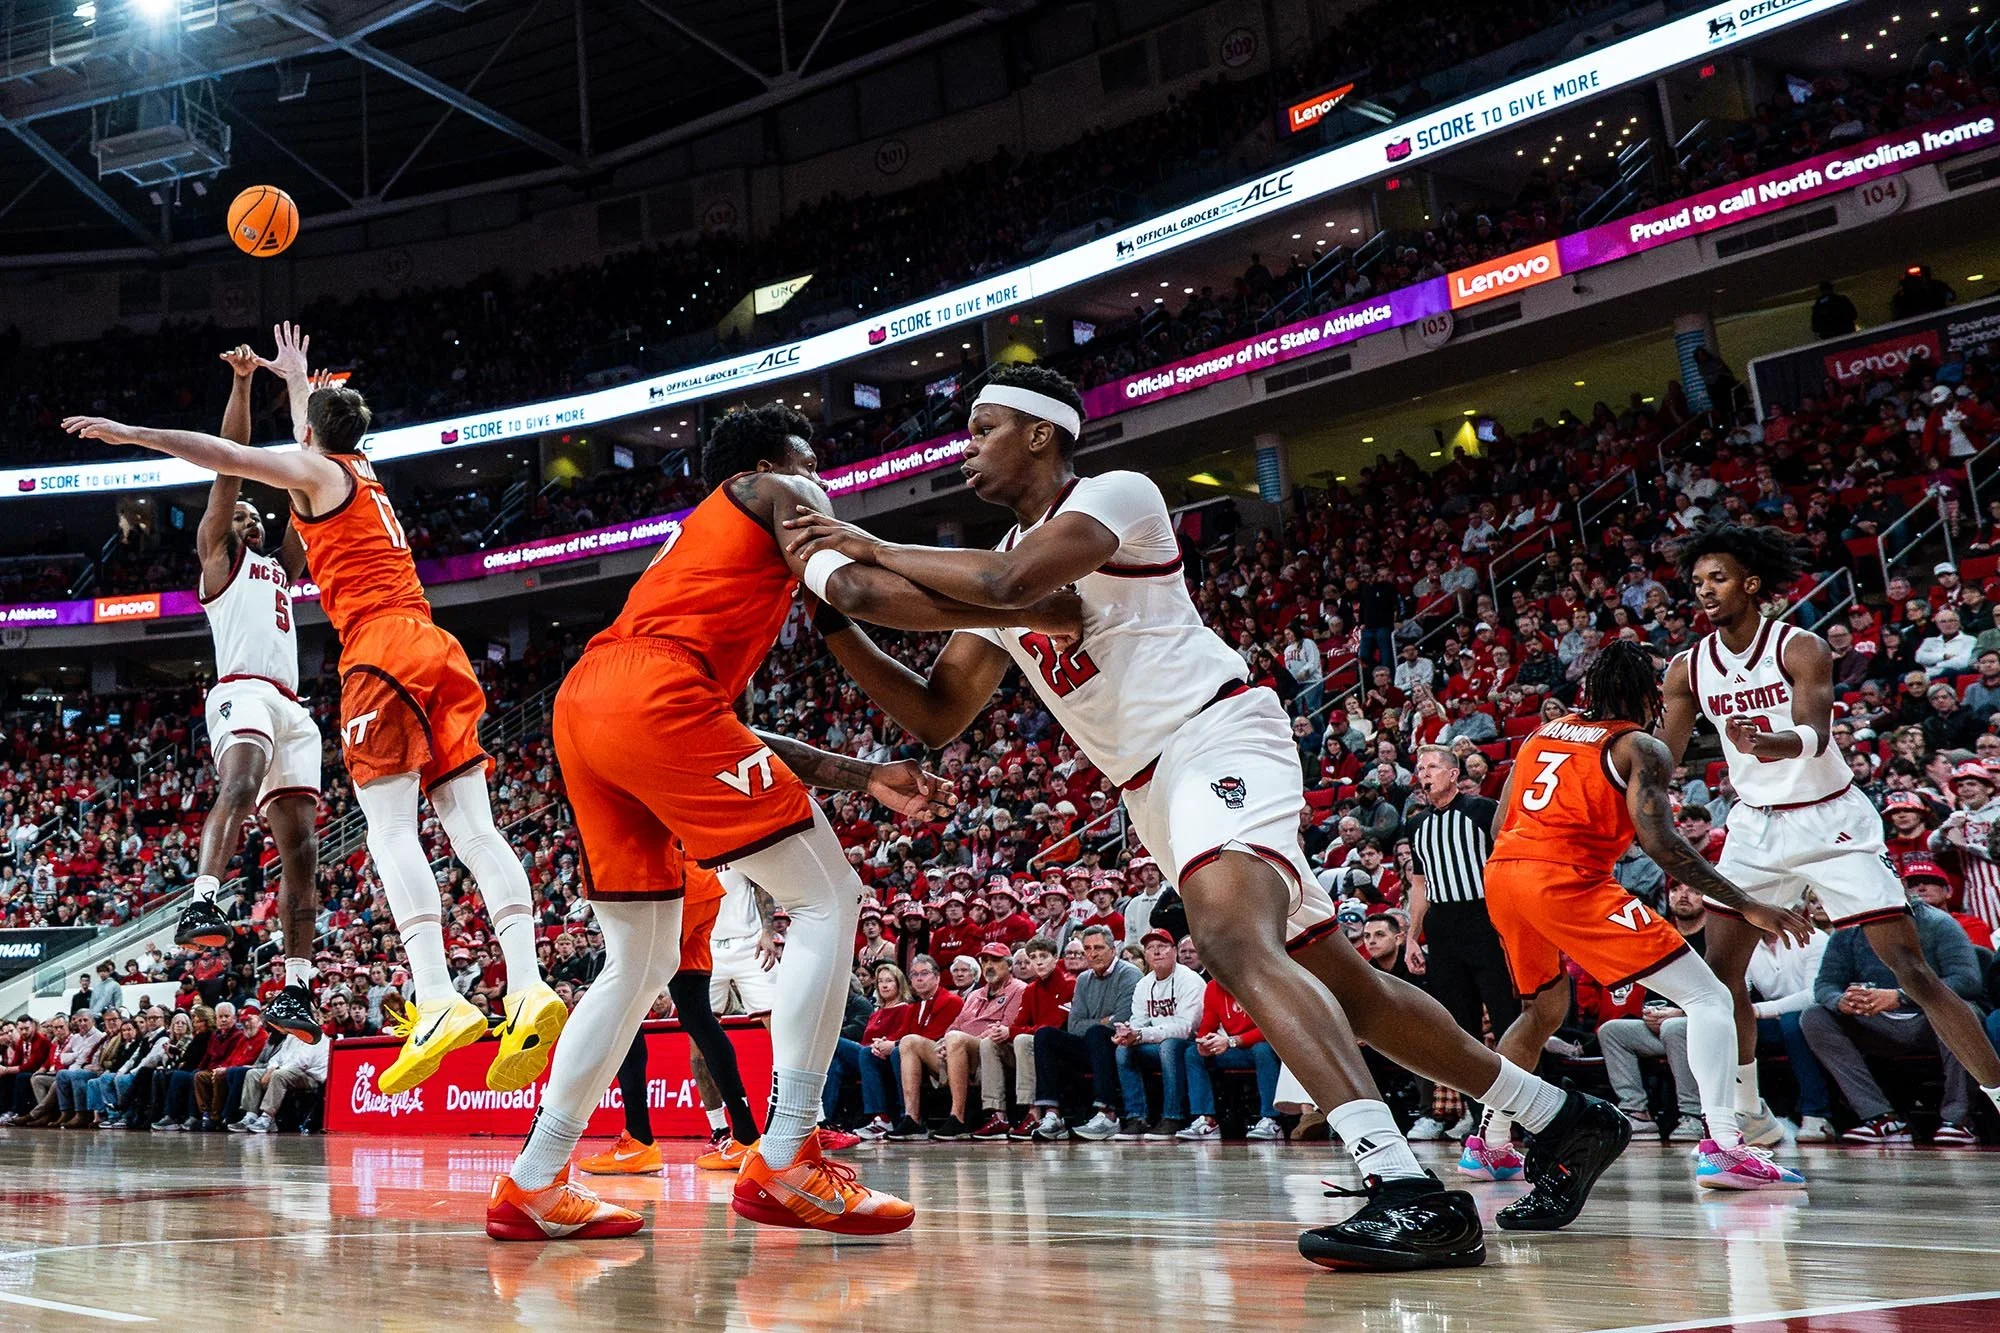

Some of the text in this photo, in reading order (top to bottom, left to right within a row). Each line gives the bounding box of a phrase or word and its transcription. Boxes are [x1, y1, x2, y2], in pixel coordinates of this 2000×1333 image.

[1740, 0, 1797, 20] OFFICI
[1294, 93, 1344, 125] Lenov
[1417, 70, 1600, 150] SCORE TO GIVE MORE
[1630, 117, 1996, 243] Proud to call North Carolina home
[1862, 179, 1897, 207] 104
[1136, 223, 1178, 245] OFFICIAL
[1181, 207, 1220, 229] GROCER
[1241, 170, 1294, 206] ACC
[1457, 255, 1550, 298] Lenovo
[890, 285, 1018, 337] SCORE TO GIVE MORE
[1422, 316, 1447, 337] 103
[666, 377, 702, 392] OFFICIAL
[705, 368, 738, 383] GROCER
[757, 345, 801, 370] ACC
[1126, 304, 1391, 398] Official Sponsor of NC State Athletics
[462, 408, 585, 441] SCORE TO GIVE MORE
[41, 471, 161, 490] SCORE TO GIVE MORE
[827, 471, 854, 492] roud
[855, 469, 869, 484] to
[869, 461, 889, 480] call
[890, 453, 923, 473] North
[484, 519, 679, 569] Official Sponsor of NC State Athletics
[249, 563, 270, 580] NC
[7, 607, 57, 621] Athletics
[99, 598, 155, 617] Lenovo
[275, 589, 290, 633] 5
[1019, 632, 1101, 698] 22
[1708, 681, 1789, 716] NC STATE
[1538, 722, 1607, 743] HAMMOND
[1522, 750, 1576, 812] 3
[446, 1082, 536, 1110] Download
